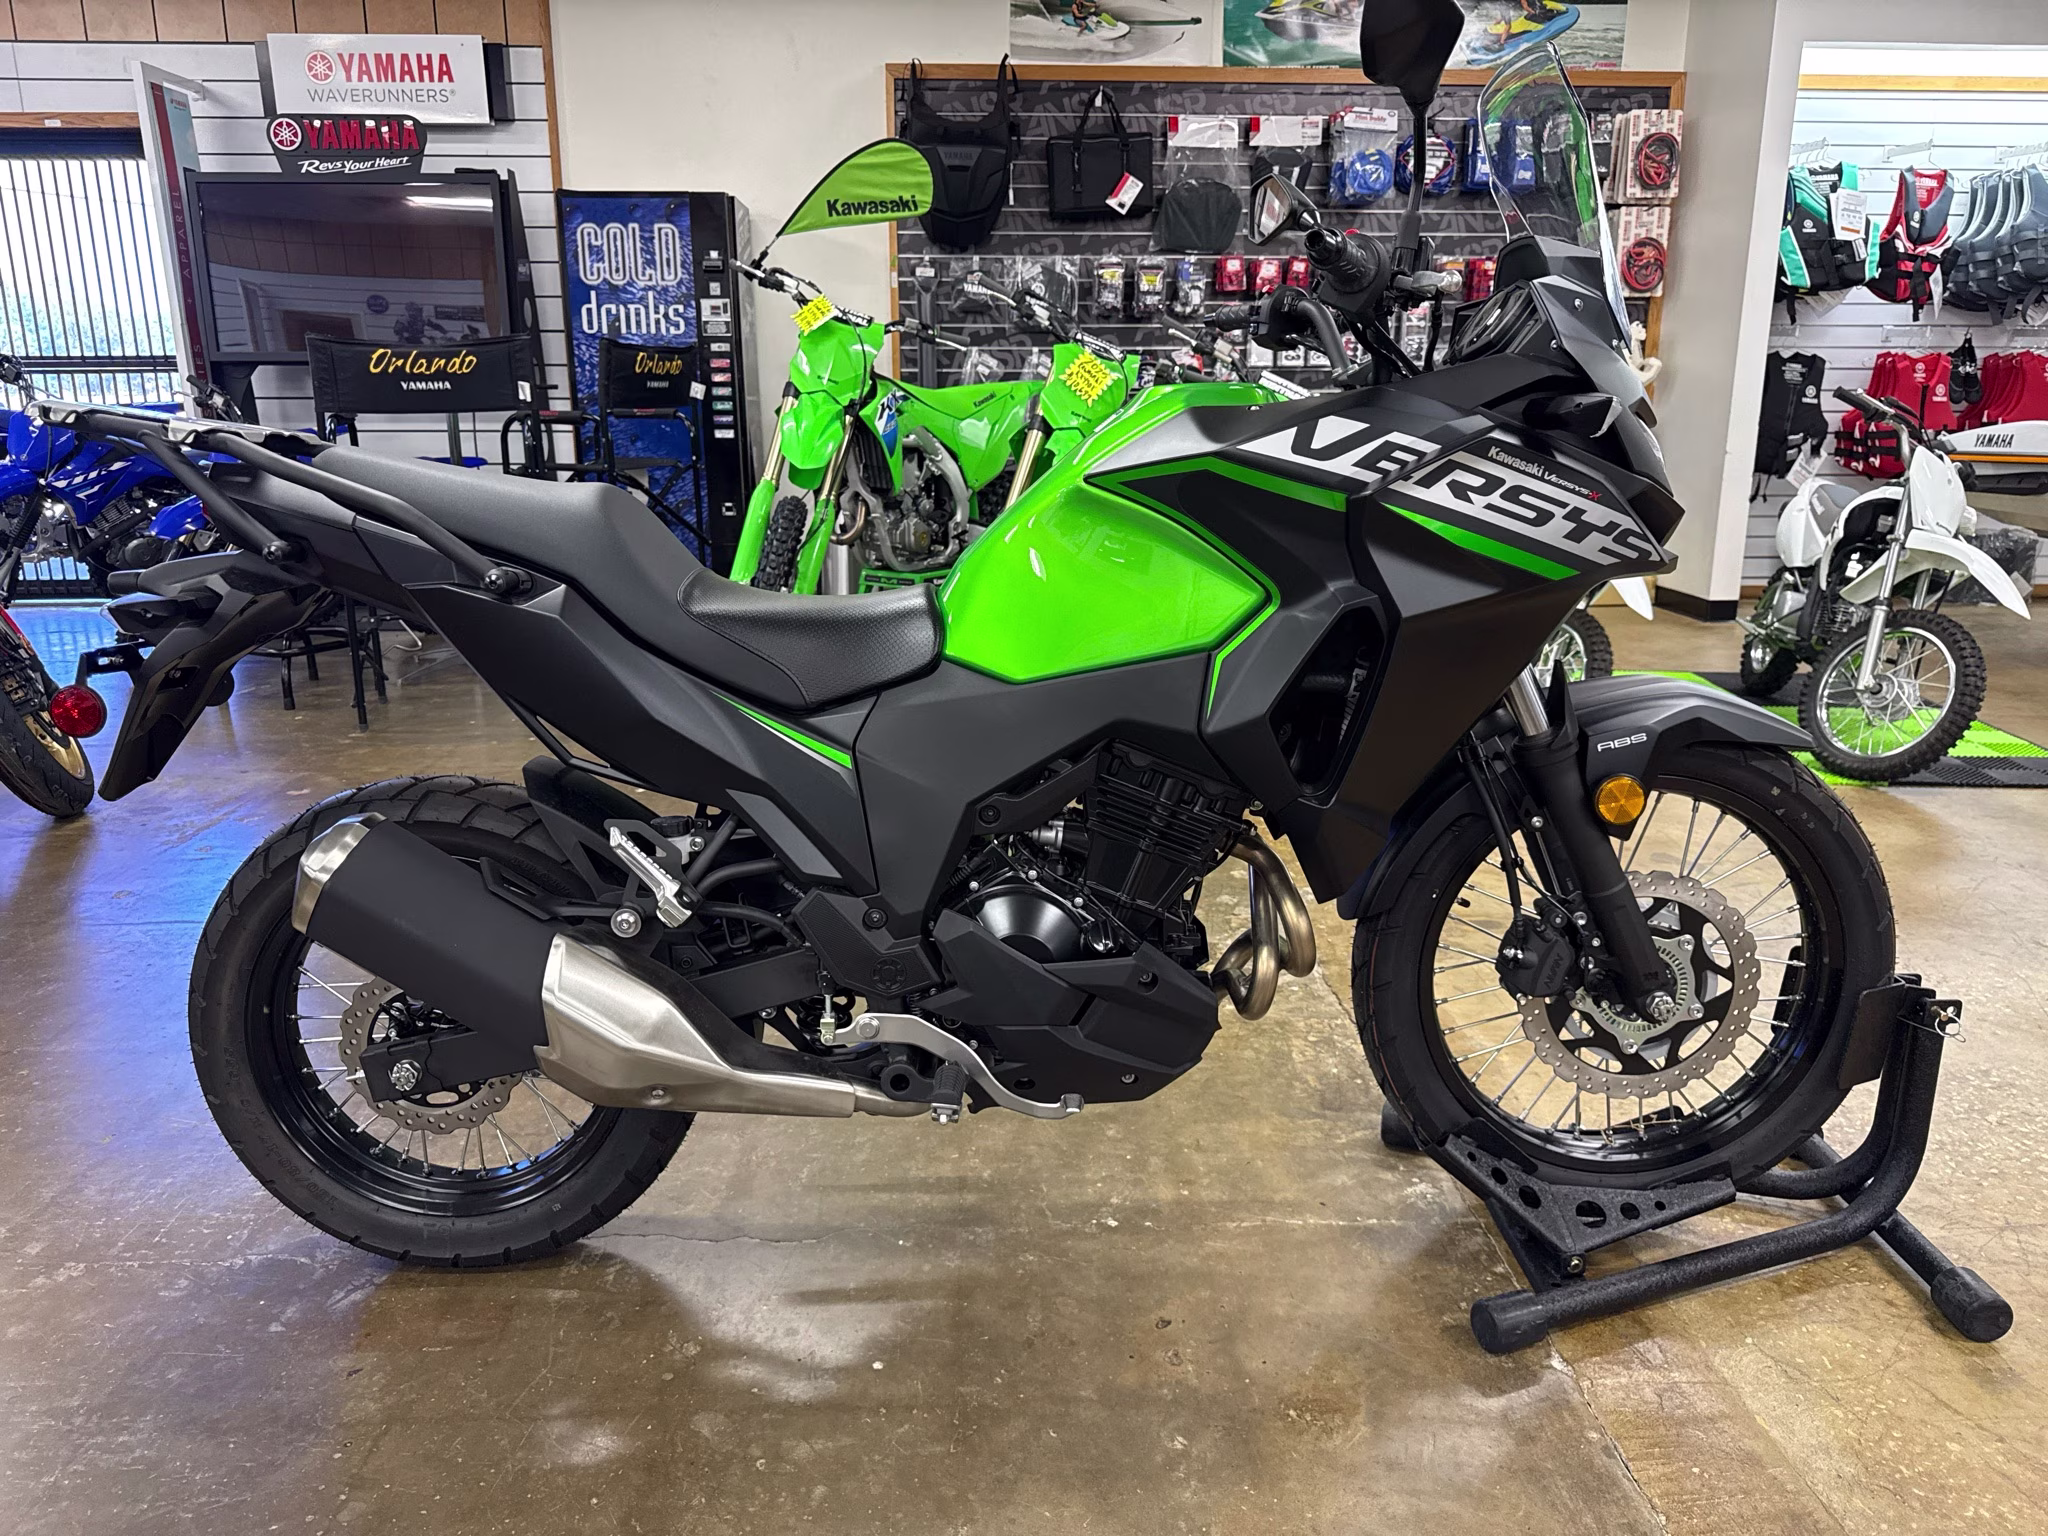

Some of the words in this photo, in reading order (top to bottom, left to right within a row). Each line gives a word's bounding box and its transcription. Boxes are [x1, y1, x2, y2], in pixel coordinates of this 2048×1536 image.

[336, 52, 455, 84] YAMAHA
[303, 119, 419, 150] YAMAHA
[826, 194, 919, 218] Kawasaki
[172, 189, 192, 279] APPAREL
[577, 222, 682, 286] COLD
[580, 289, 686, 336] drinks
[368, 347, 479, 375] Orlando
[635, 351, 683, 376] Orlando
[400, 381, 452, 391] YAMAHA
[1974, 433, 2015, 449] YAMAHA
[1487, 445, 1545, 478] Kawasaki
[1288, 418, 1661, 563] VERSYS
[1596, 732, 1648, 753] ABS
